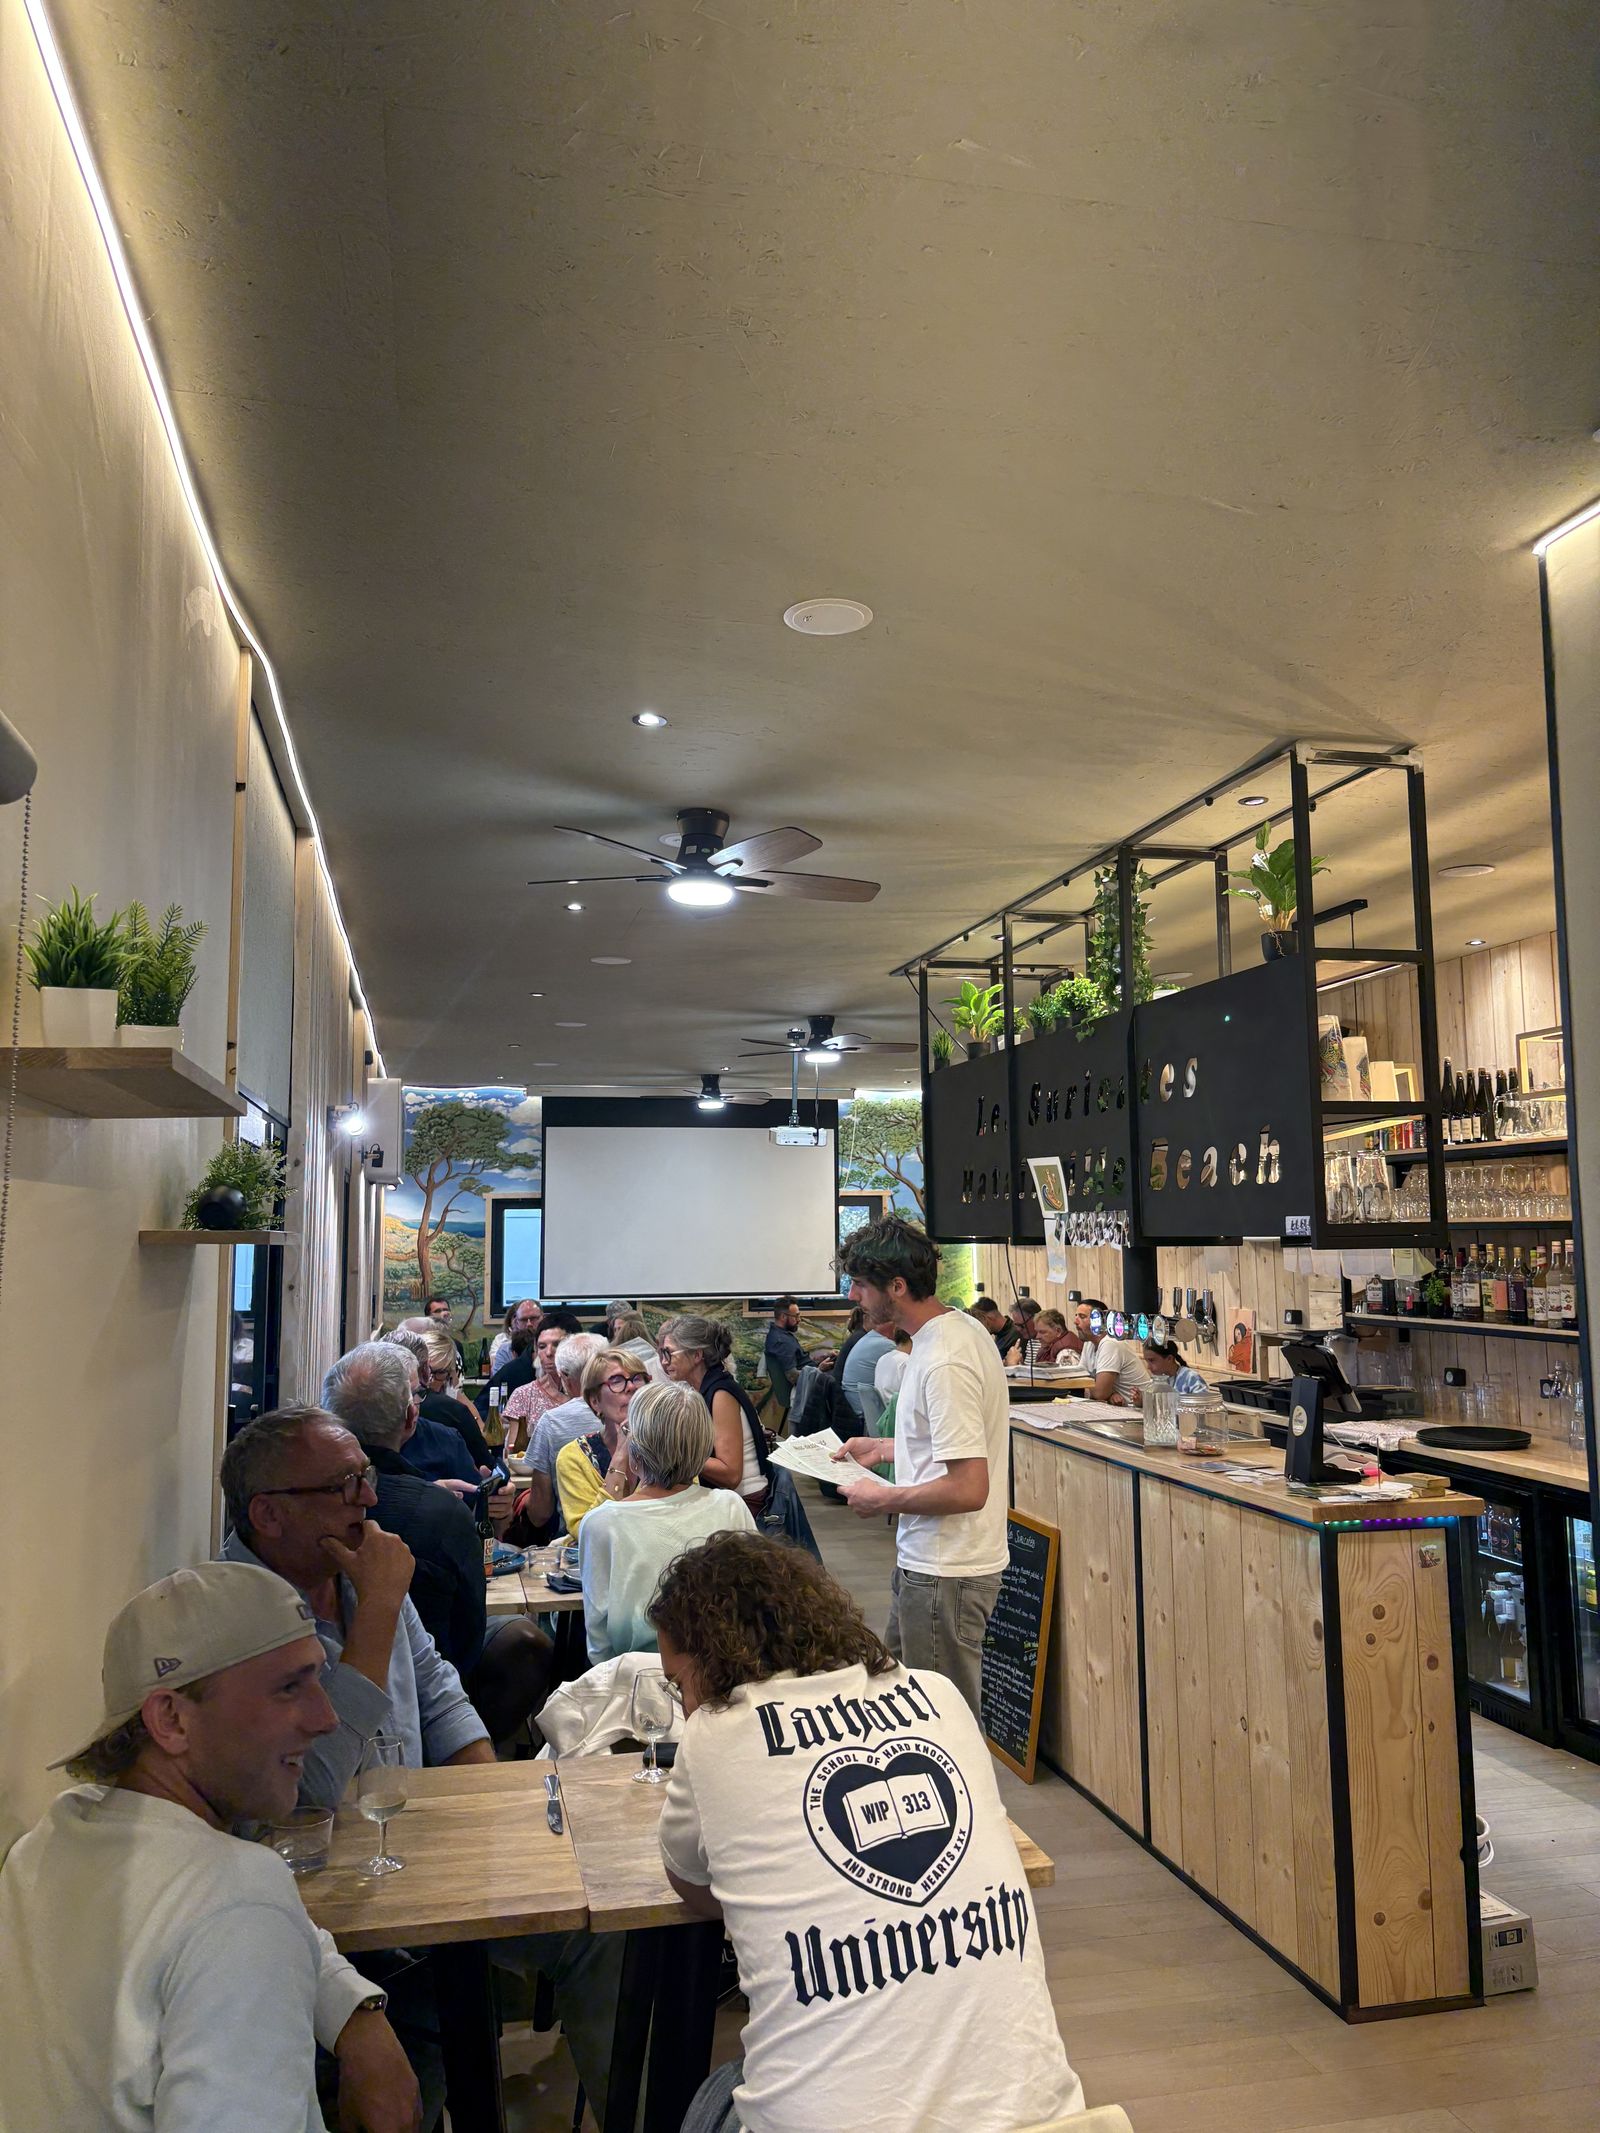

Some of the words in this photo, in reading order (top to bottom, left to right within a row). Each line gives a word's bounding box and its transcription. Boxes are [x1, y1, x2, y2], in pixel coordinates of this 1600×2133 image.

[1149, 1123, 1280, 1191] Beach
[810, 1787, 822, 1810] THE
[817, 1753, 859, 1781] SCHOOL
[866, 1755, 881, 1766] OF
[882, 1743, 911, 1759] HARD
[915, 1743, 955, 1775] KNOCKS
[860, 1800, 889, 1825] WIP
[902, 1790, 931, 1814] 313
[842, 1857, 865, 1878] AND
[866, 1872, 913, 1898] STRONG
[920, 1851, 956, 1892] HEARTS
[784, 1881, 1029, 2006] University
